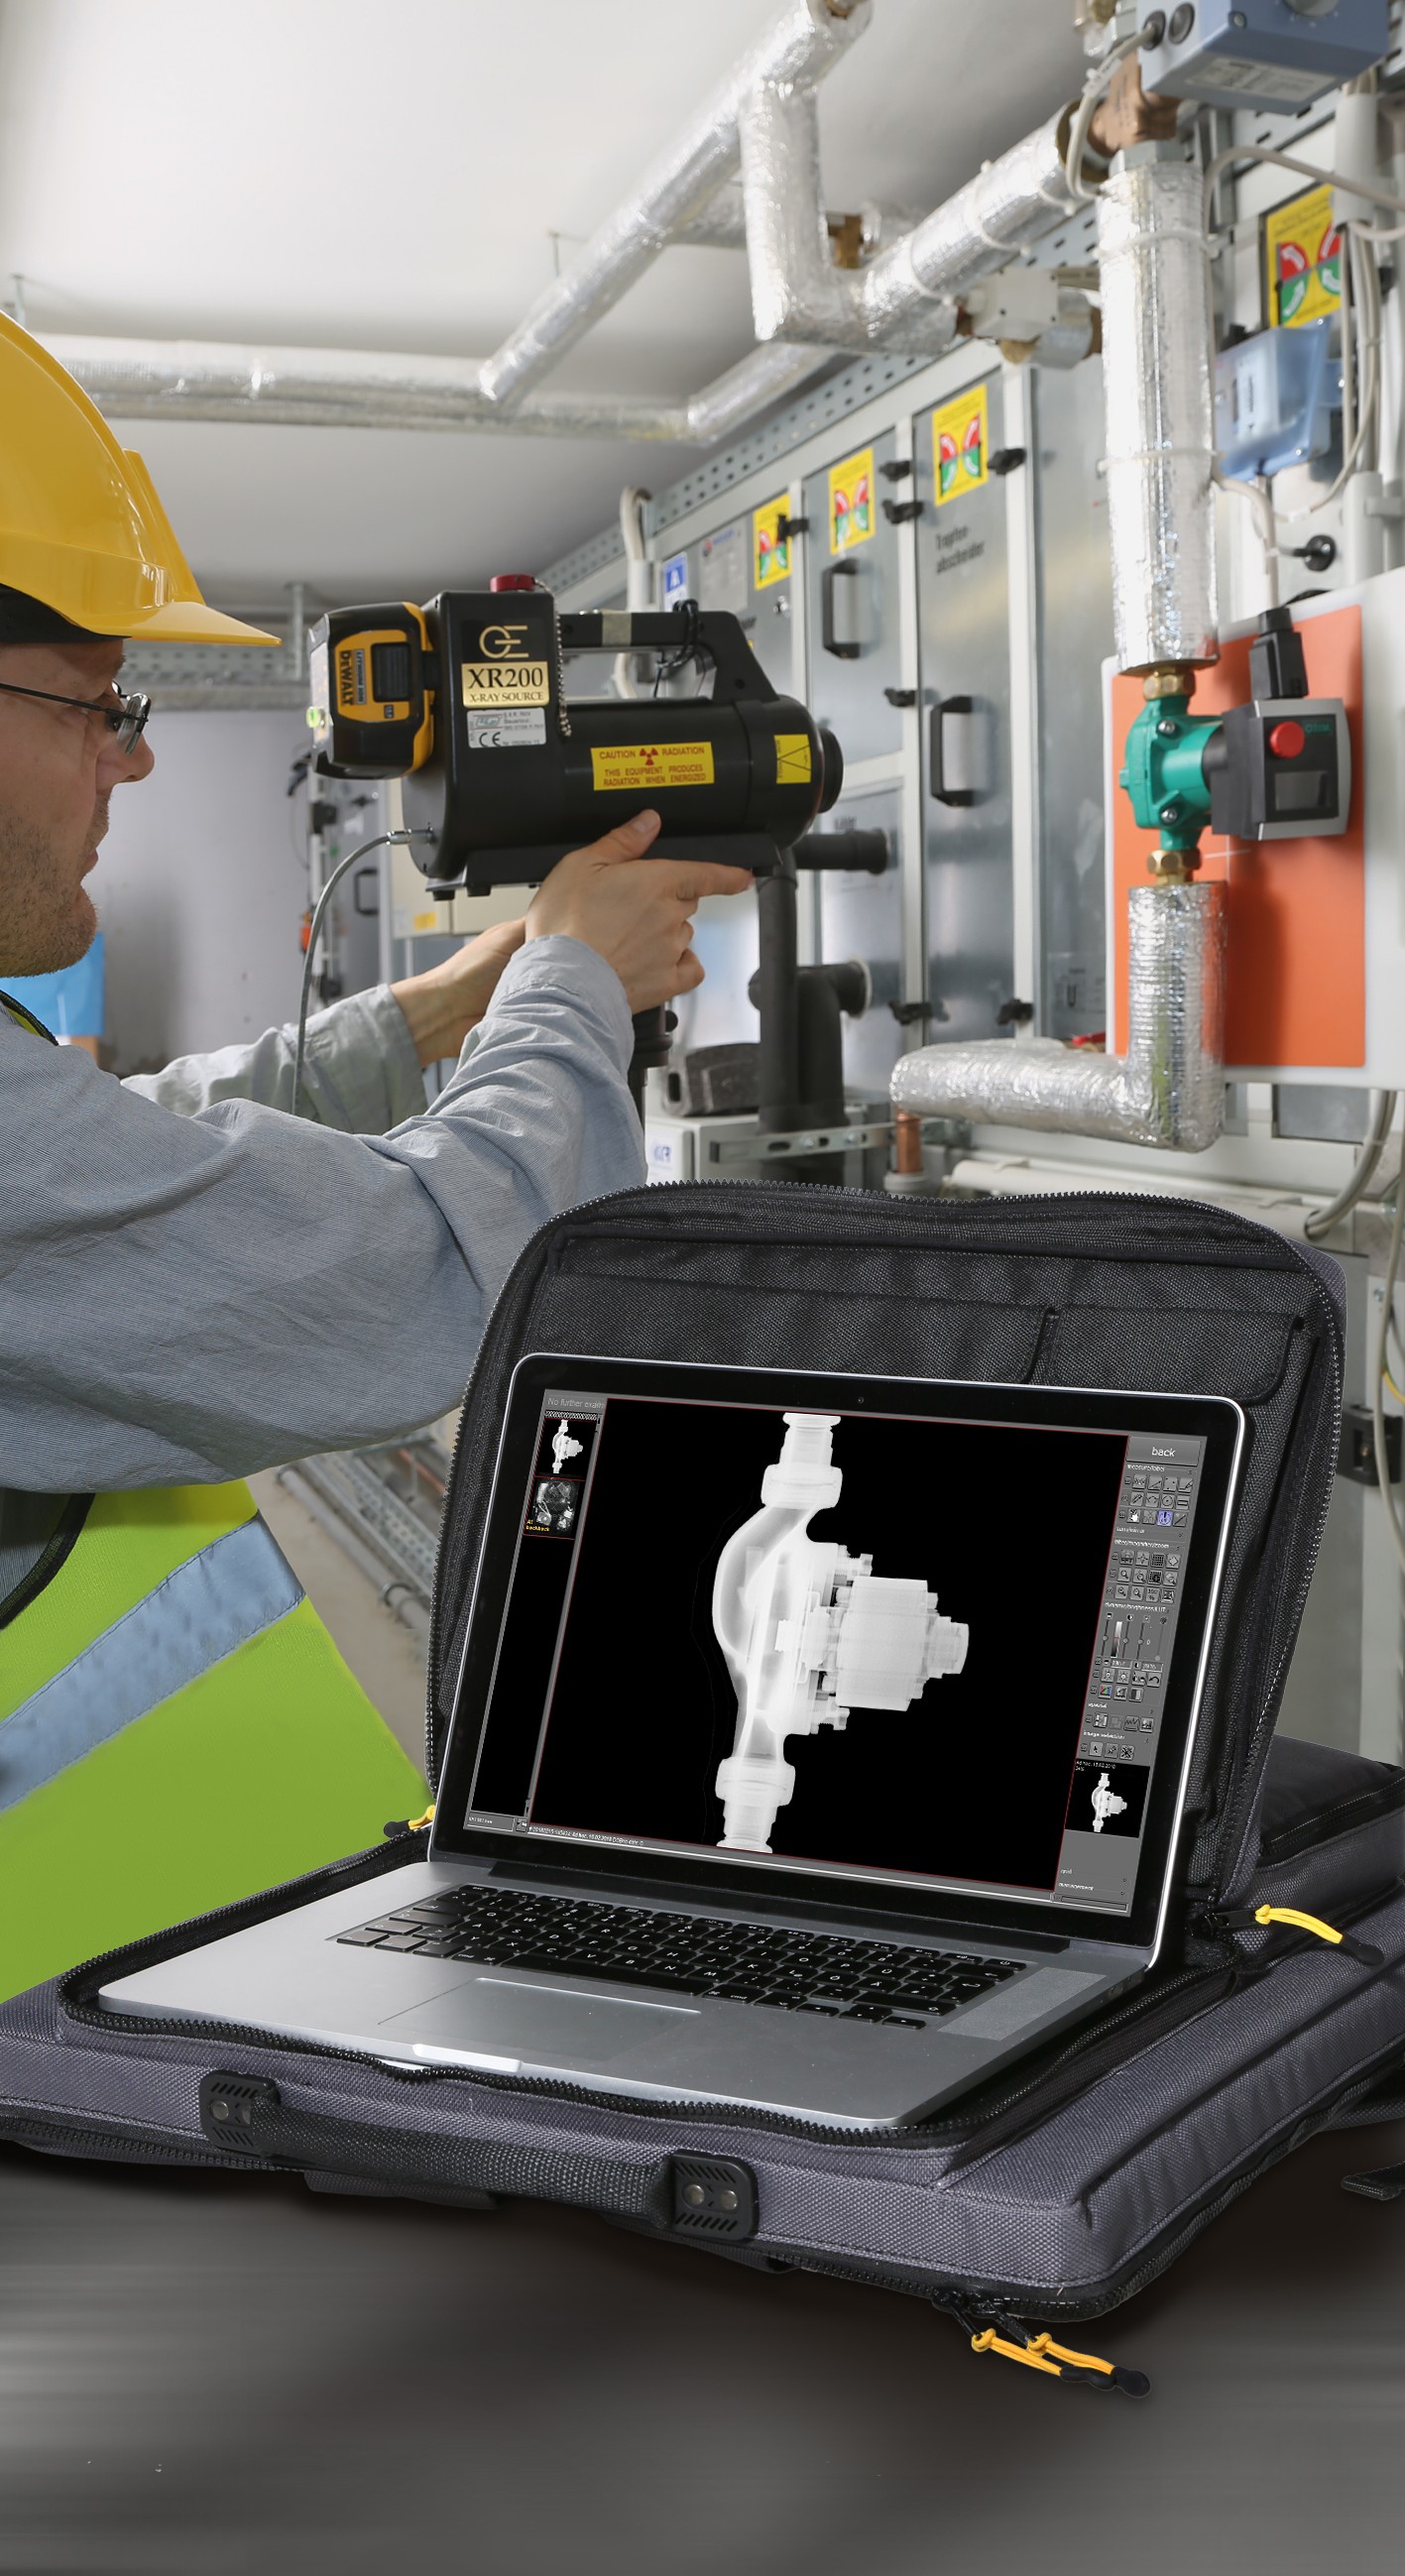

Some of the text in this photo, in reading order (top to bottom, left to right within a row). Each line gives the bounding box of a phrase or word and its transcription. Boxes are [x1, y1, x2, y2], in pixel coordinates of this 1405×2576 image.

[468, 667, 543, 689] XR200
[470, 691, 544, 702] X-RAY SOURCE
[599, 746, 705, 760] CAUTION RADIATION
[625, 766, 662, 775] EQUIPMENT
[668, 763, 703, 773] PRODUCES
[603, 772, 706, 786] RADIATION WHEN ENERGIZED
[560, 1398, 583, 1407] further
[1151, 1447, 1176, 1457] back
